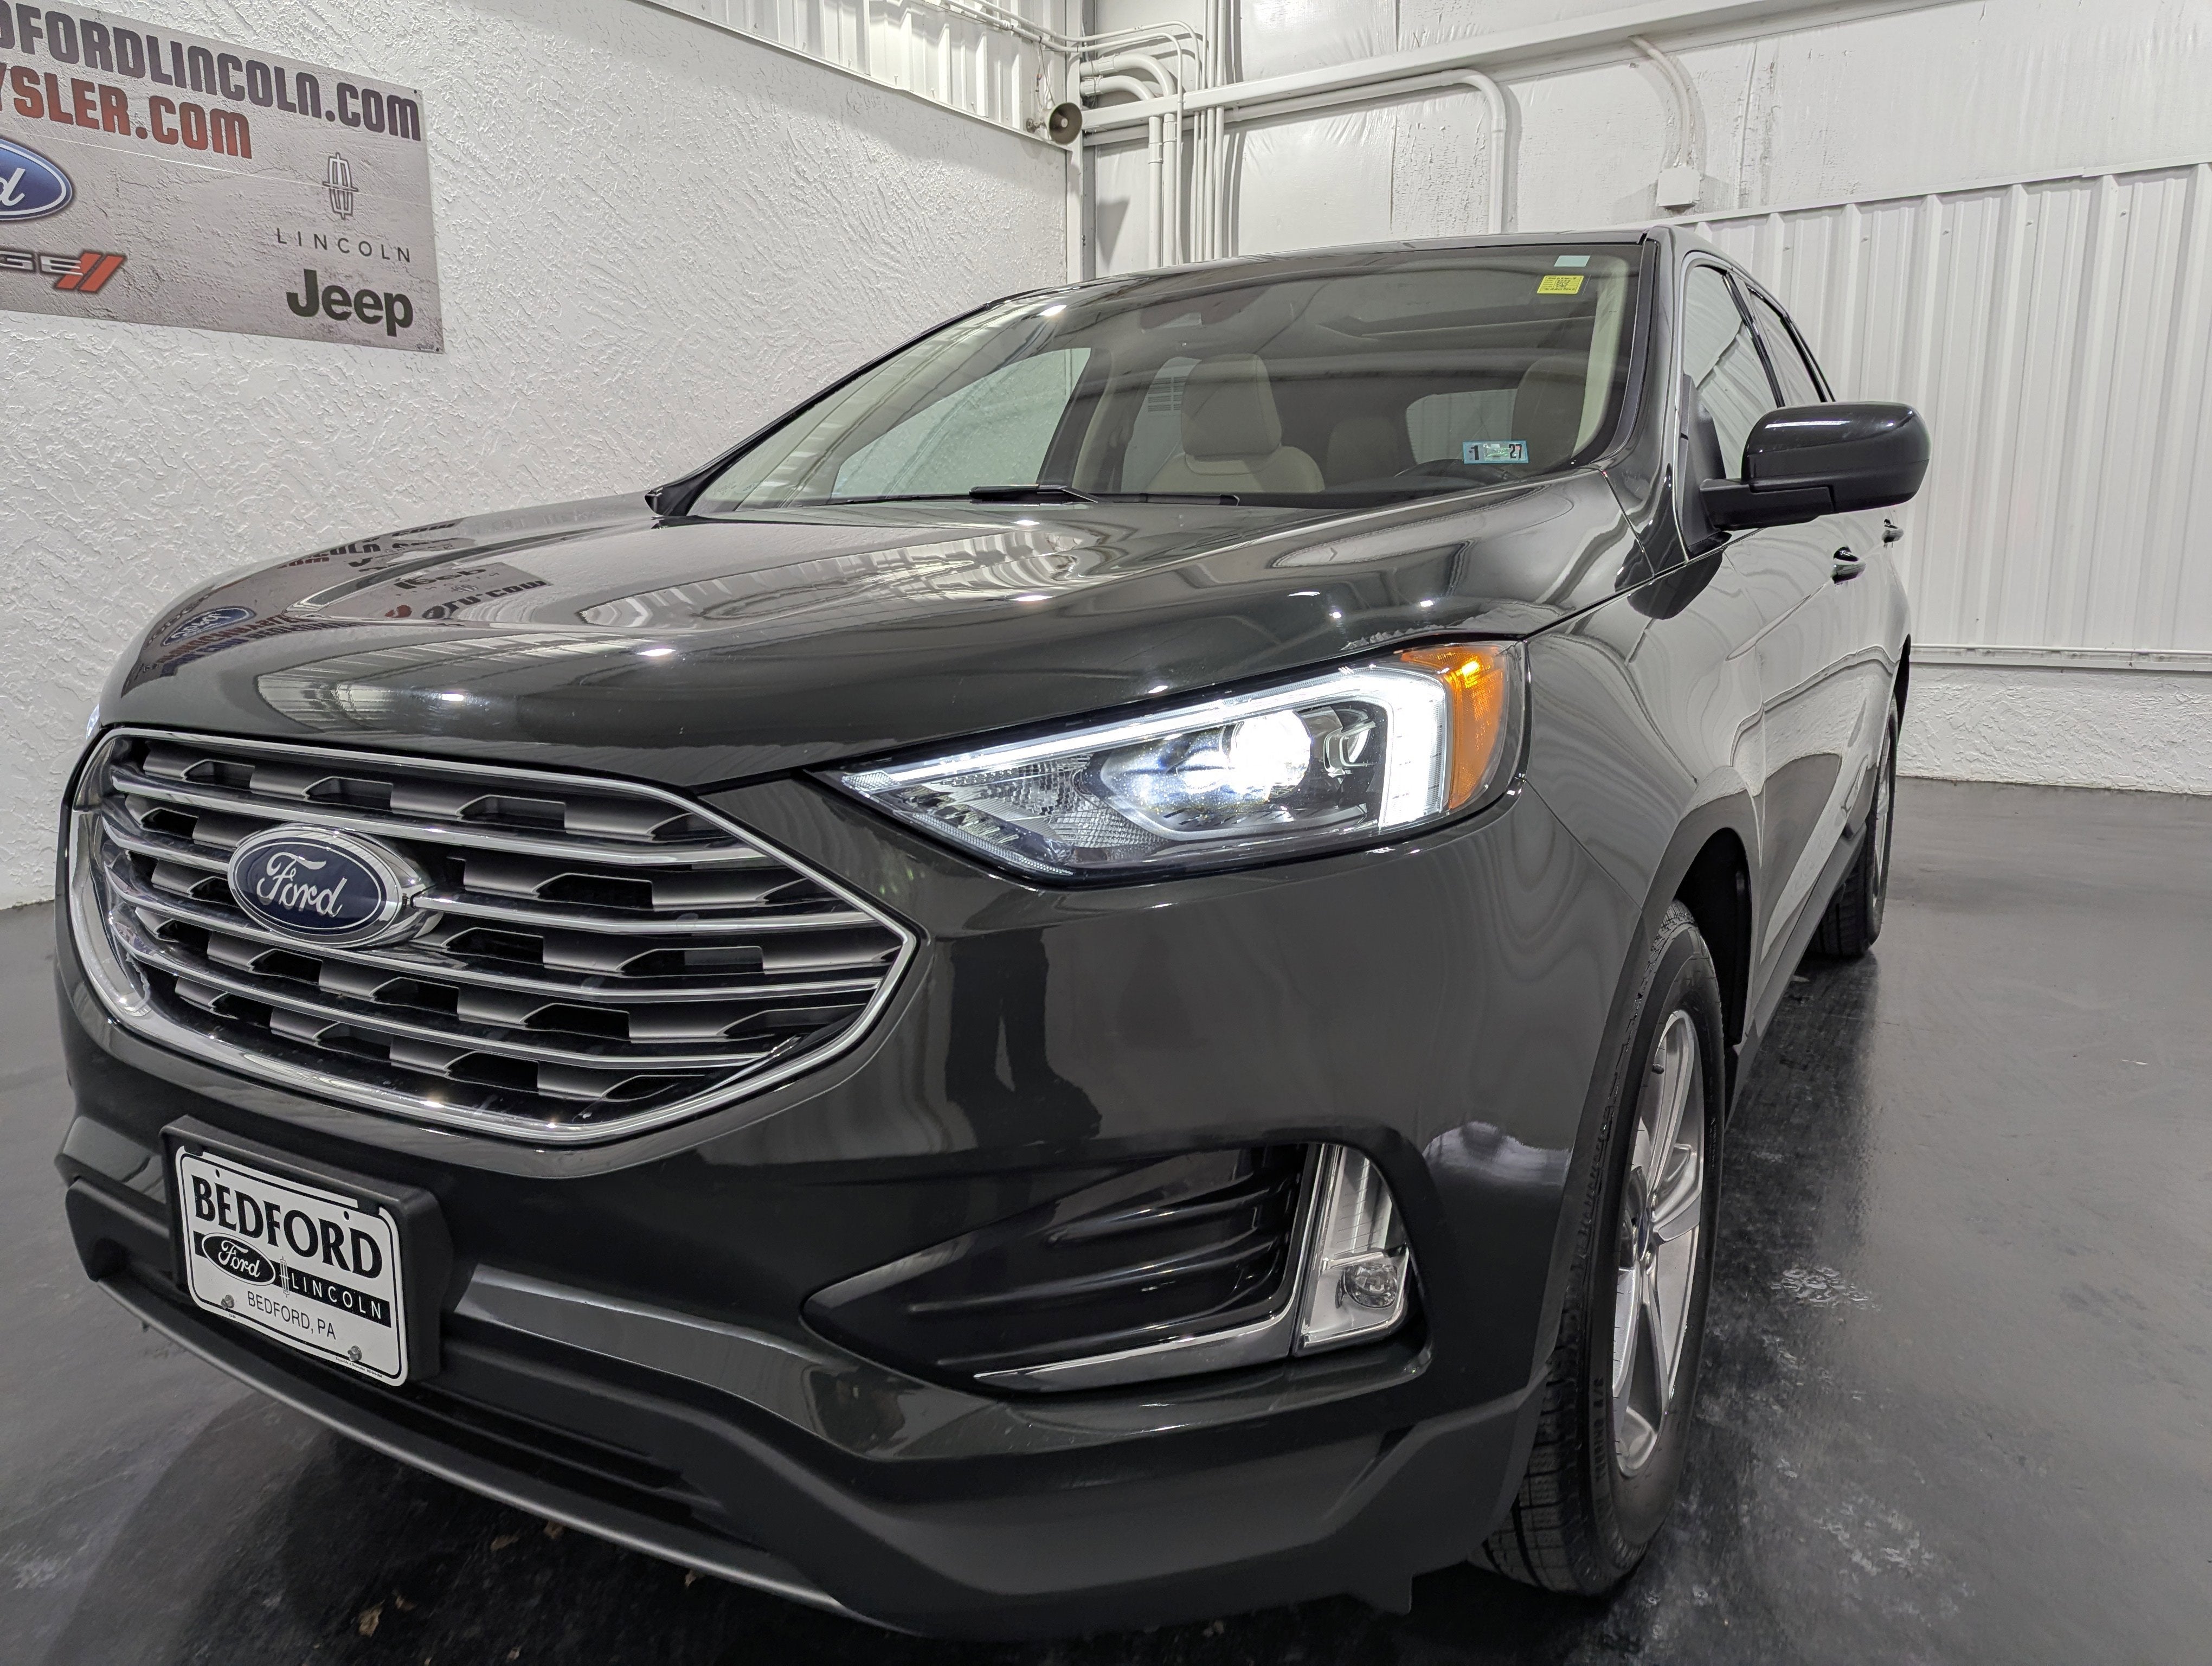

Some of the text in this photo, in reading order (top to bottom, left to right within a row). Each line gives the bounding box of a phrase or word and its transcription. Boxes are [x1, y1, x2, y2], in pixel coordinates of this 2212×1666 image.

[0, 62, 252, 159] SLER.COM
[277, 228, 410, 264] LINCOLN
[286, 269, 414, 336] Jeep
[1509, 444, 1522, 459] 27
[256, 851, 348, 918] Ford
[191, 1175, 382, 1278] BEDFORD
[218, 1240, 260, 1278] Ford
[247, 1290, 336, 1340] BEDFORD, PA
[292, 1272, 381, 1319] LINCOLN
